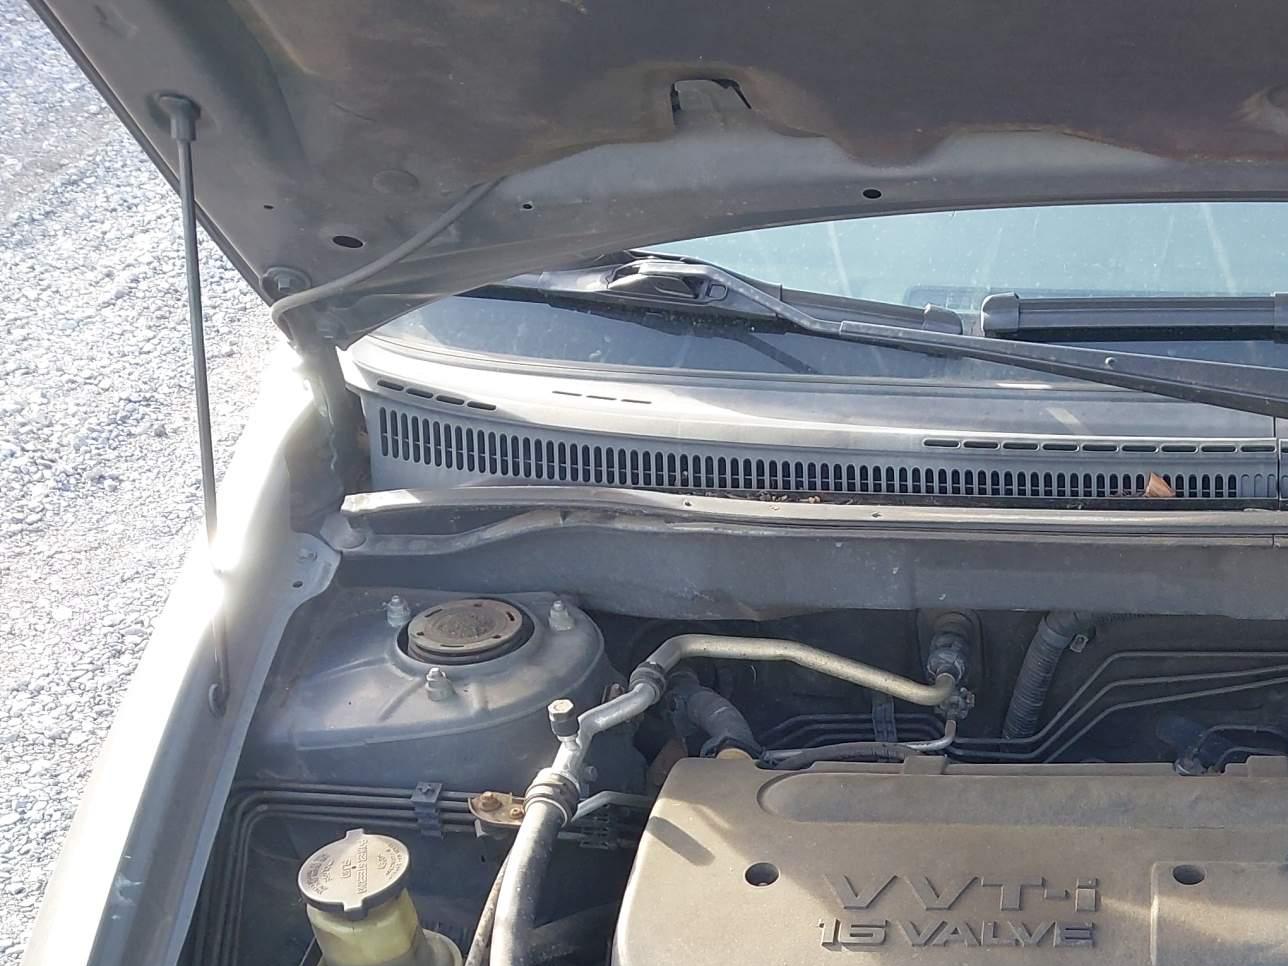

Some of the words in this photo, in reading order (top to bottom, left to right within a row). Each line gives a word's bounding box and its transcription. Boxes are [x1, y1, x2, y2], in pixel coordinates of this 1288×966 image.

[824, 874, 1099, 912] VVT-i
[818, 918, 889, 951] 16
[897, 919, 1096, 948] VALVE
